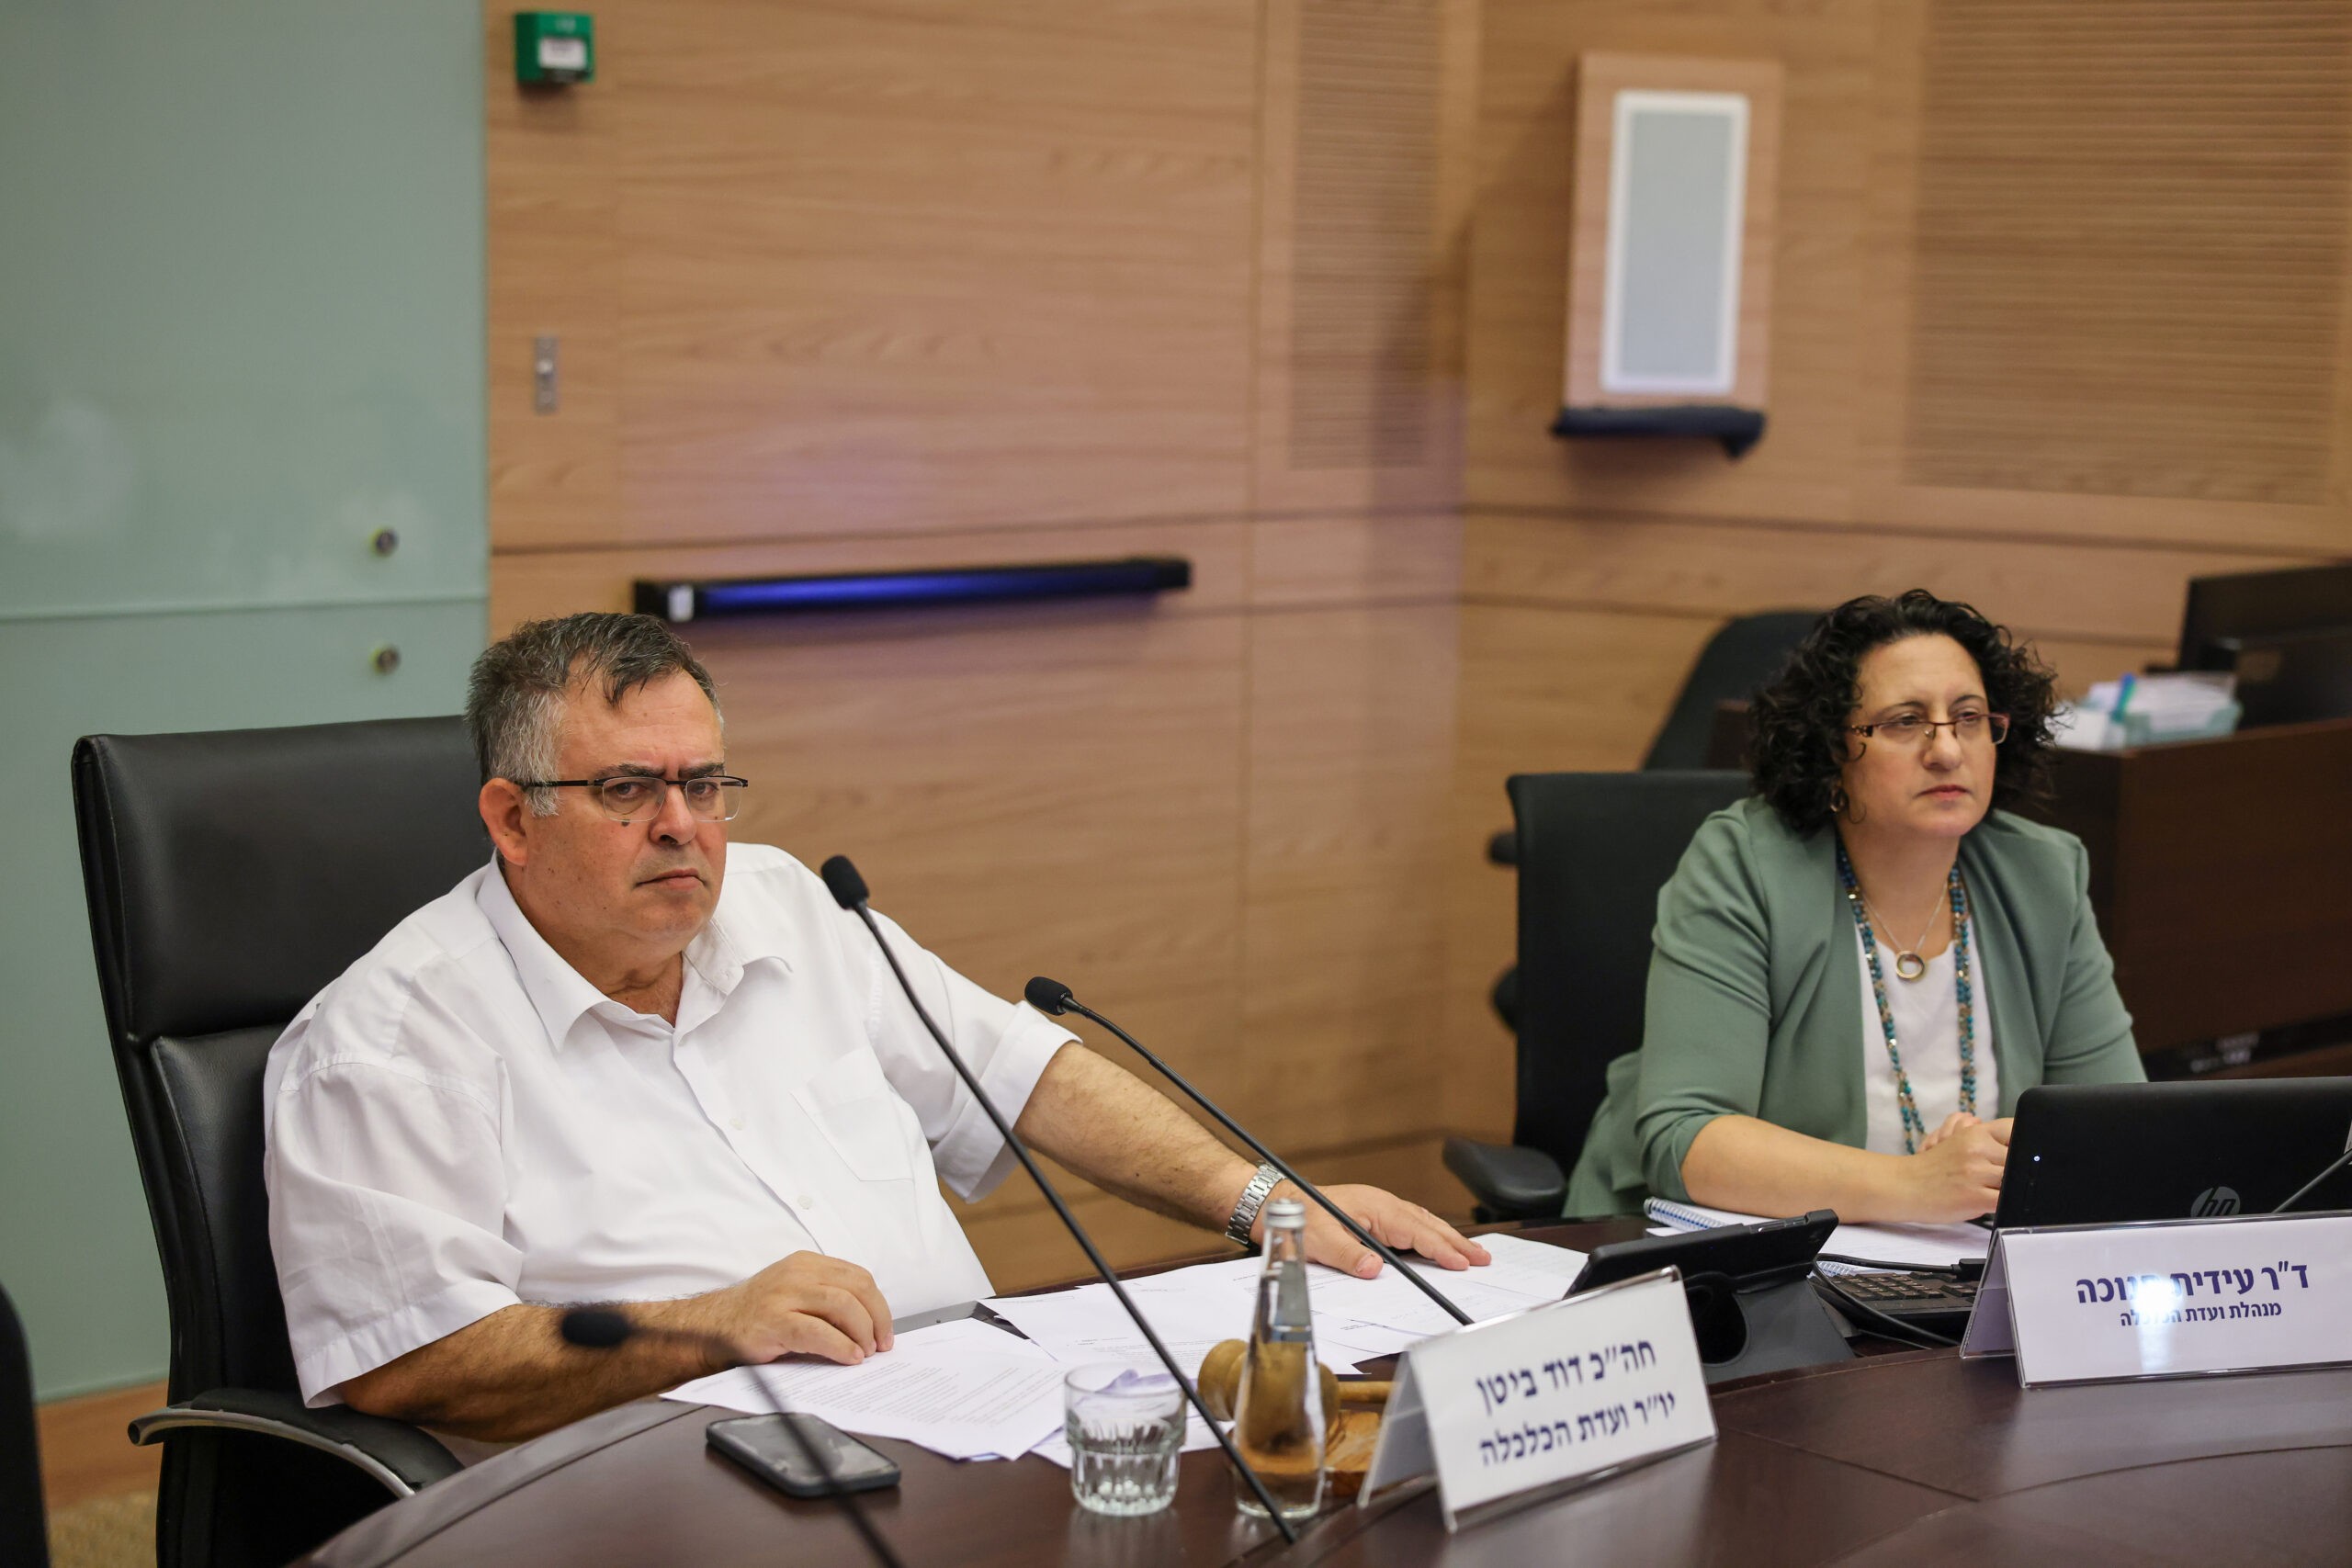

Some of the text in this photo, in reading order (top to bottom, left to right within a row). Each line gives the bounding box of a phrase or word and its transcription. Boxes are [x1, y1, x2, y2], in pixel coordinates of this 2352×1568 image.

[2075, 1260, 2309, 1304] ד"ר עידית נוכה
[2185, 1305, 2226, 1323] ועדת
[2228, 1301, 2282, 1319] מנהלת
[1543, 1355, 1584, 1389] דוד
[1476, 1368, 1539, 1416] ביטן
[1479, 1391, 1676, 1466] יו"ר ועדת הכלכלה
